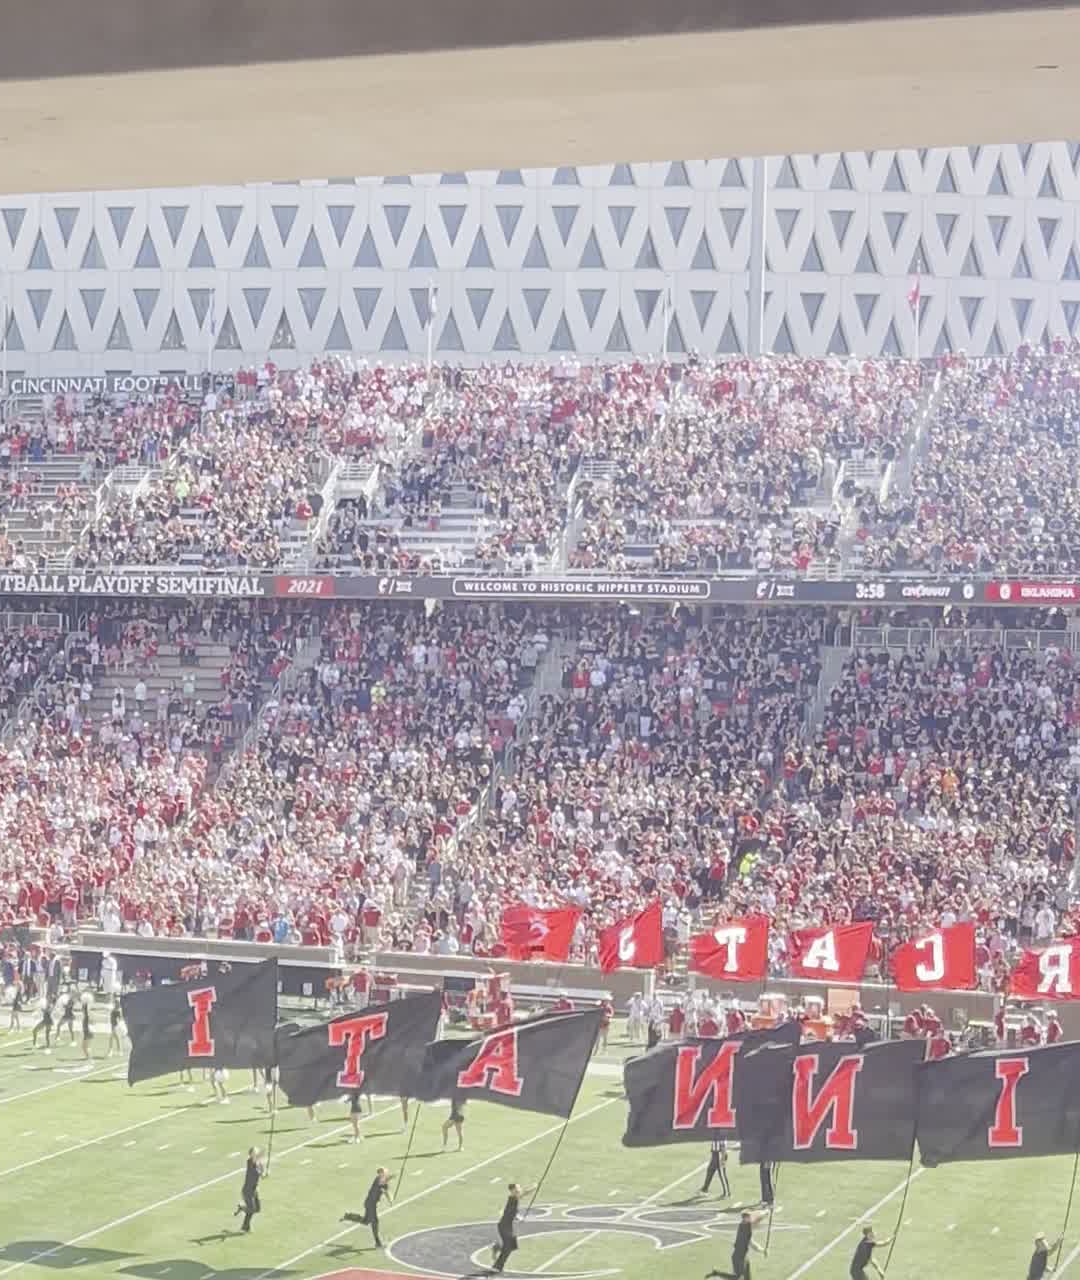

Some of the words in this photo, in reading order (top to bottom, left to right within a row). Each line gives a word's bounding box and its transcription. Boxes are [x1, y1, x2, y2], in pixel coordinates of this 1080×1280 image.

[11, 377, 107, 393] CINCINNATI
[68, 576, 156, 593] PLAYOFF
[157, 577, 264, 595] SEMIFINAL
[288, 580, 322, 593] 2021
[464, 582, 518, 591] WELCOME
[522, 583, 537, 591] TO
[541, 583, 593, 592] HISTORIC
[597, 583, 644, 593] NIPPERT
[647, 584, 700, 594] STADIUM
[856, 584, 885, 599] 3:58
[963, 585, 974, 599] 0
